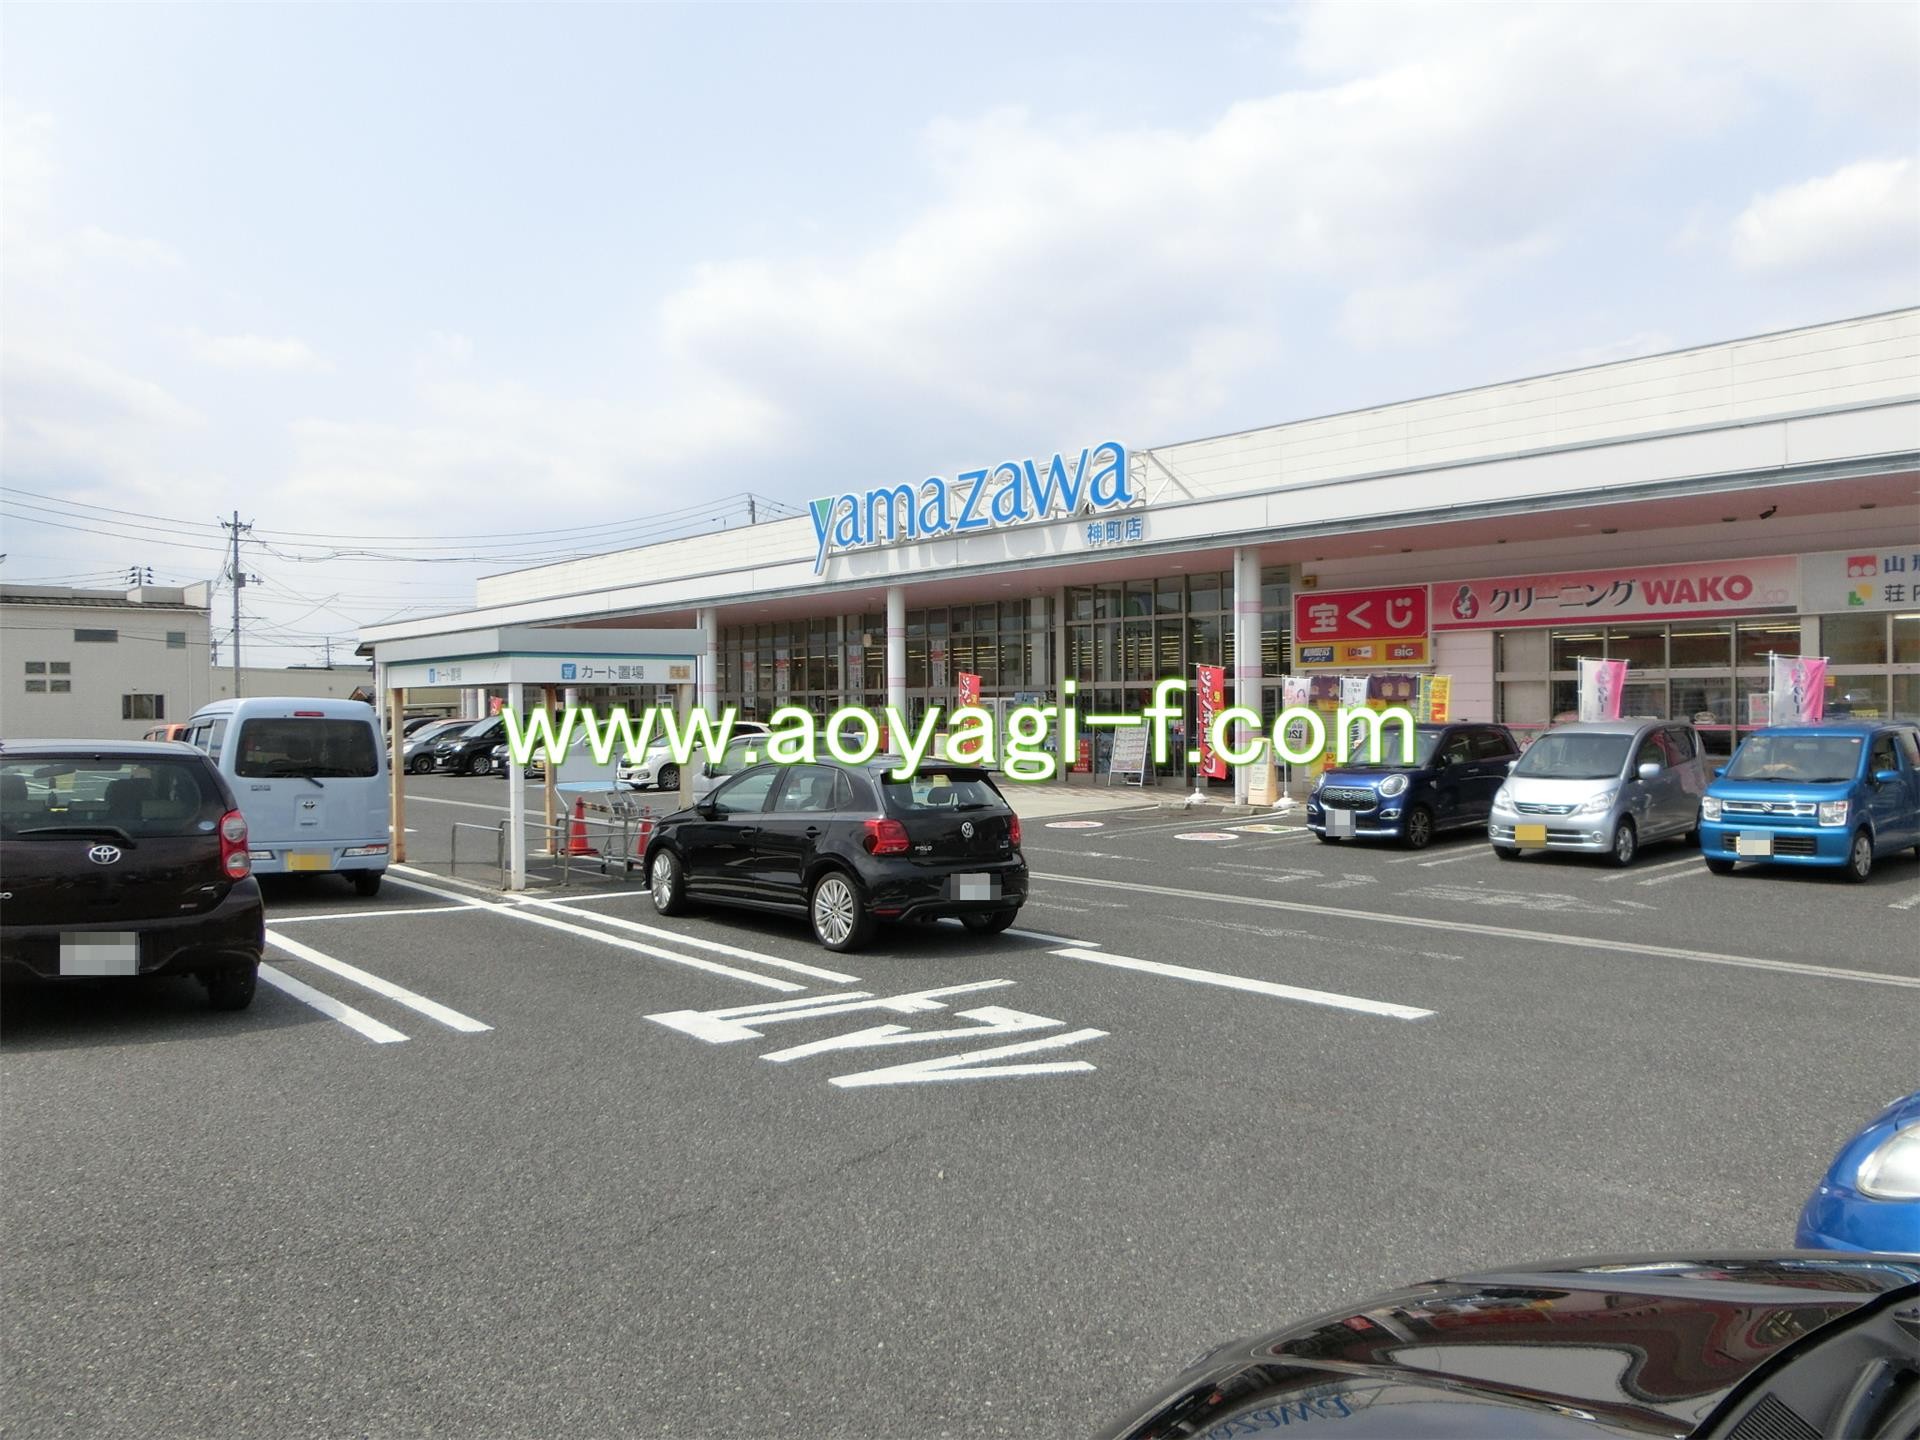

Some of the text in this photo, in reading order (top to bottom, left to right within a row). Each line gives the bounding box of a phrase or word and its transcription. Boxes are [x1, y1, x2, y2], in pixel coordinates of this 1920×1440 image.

[808, 441, 1133, 575] yamazawa
[1087, 517, 1142, 545] 神町店
[1489, 578, 1637, 613] クリーニング
[1642, 575, 1753, 606] WAKO
[1308, 597, 1413, 633] 宝くじ
[582, 665, 645, 680] カート置場
